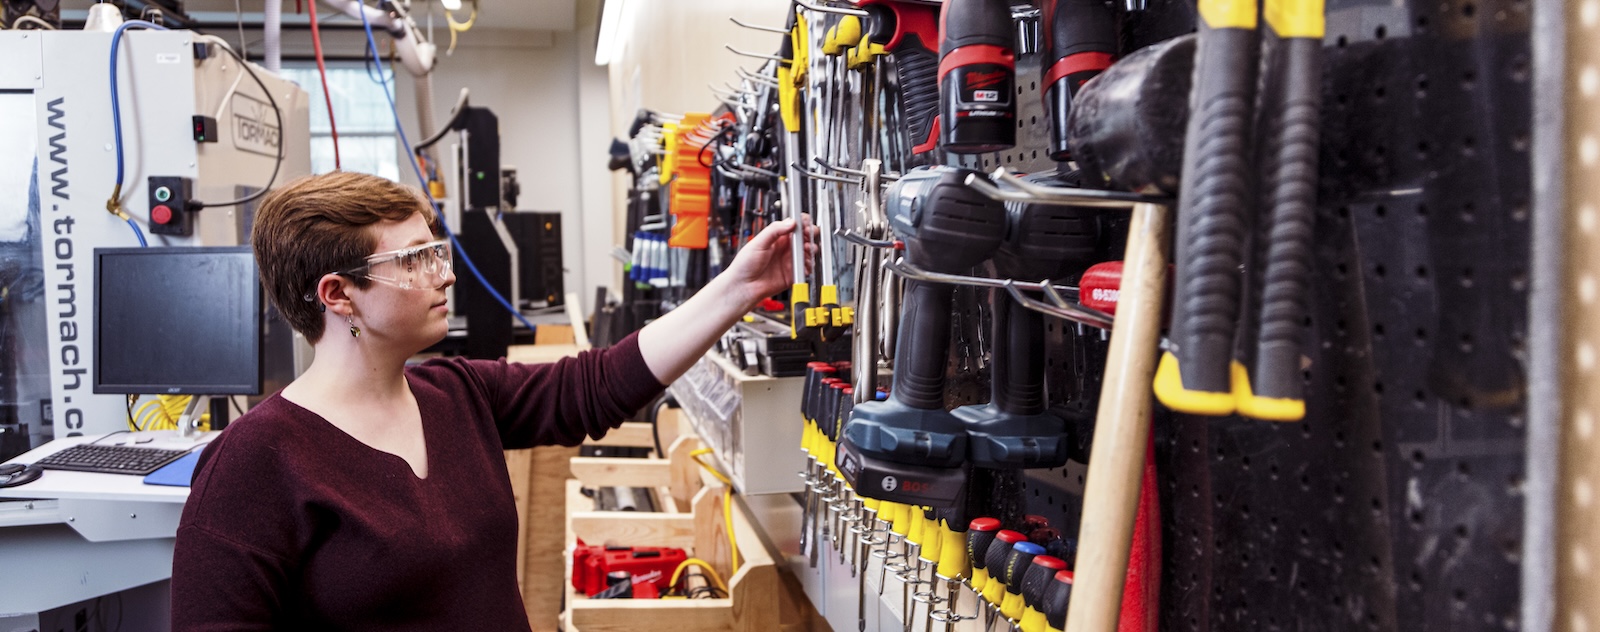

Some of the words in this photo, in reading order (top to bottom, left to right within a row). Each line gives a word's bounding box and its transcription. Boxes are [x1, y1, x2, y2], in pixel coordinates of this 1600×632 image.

[234, 112, 282, 148] TORMAC
[46, 96, 88, 438] www.tormach.c
[902, 480, 931, 495] BOS
